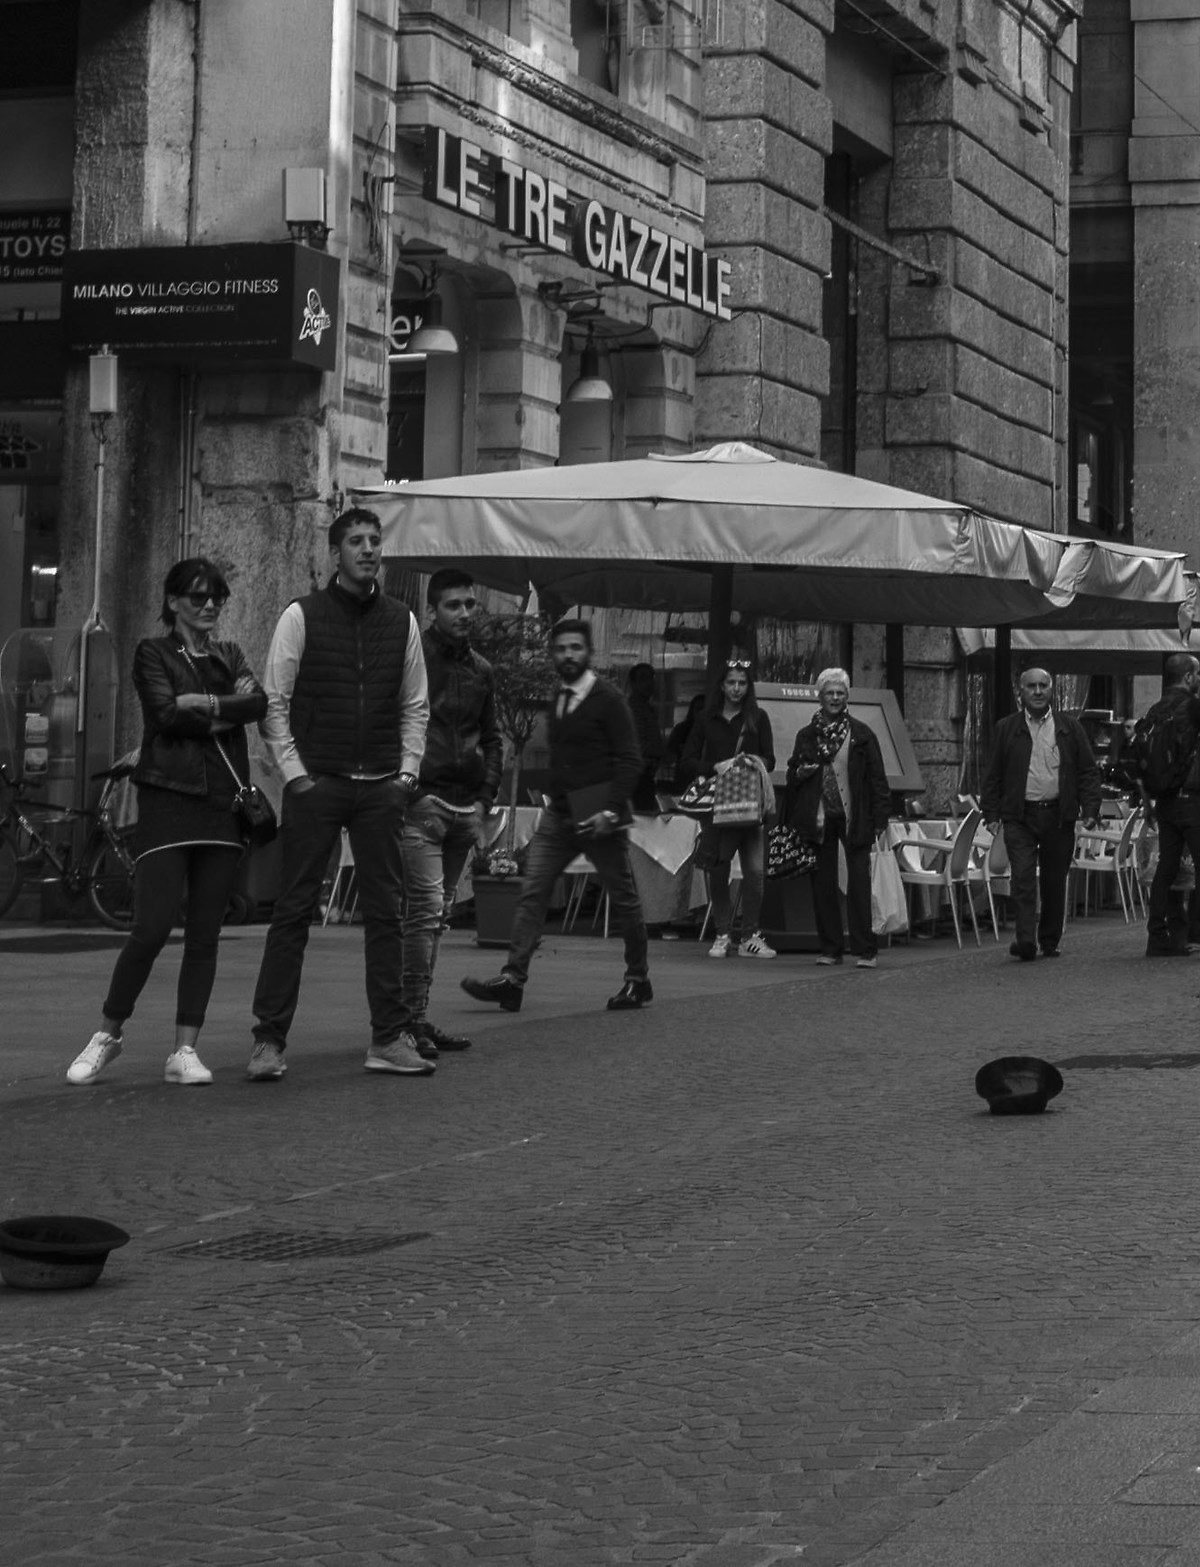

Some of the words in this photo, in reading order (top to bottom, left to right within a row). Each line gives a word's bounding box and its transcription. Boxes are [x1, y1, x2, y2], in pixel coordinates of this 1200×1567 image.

[436, 126, 481, 216] LE
[501, 157, 567, 252] TRE
[584, 200, 732, 322] GAZZELLE
[0, 234, 66, 258] TOYS
[73, 284, 134, 299] MILANO
[137, 281, 221, 297] VILLAGGIO
[224, 279, 279, 296] FITNESS
[129, 306, 157, 315] VIRGIN
[158, 305, 184, 314] ACTIVE
[185, 304, 235, 313] COLLECTION
